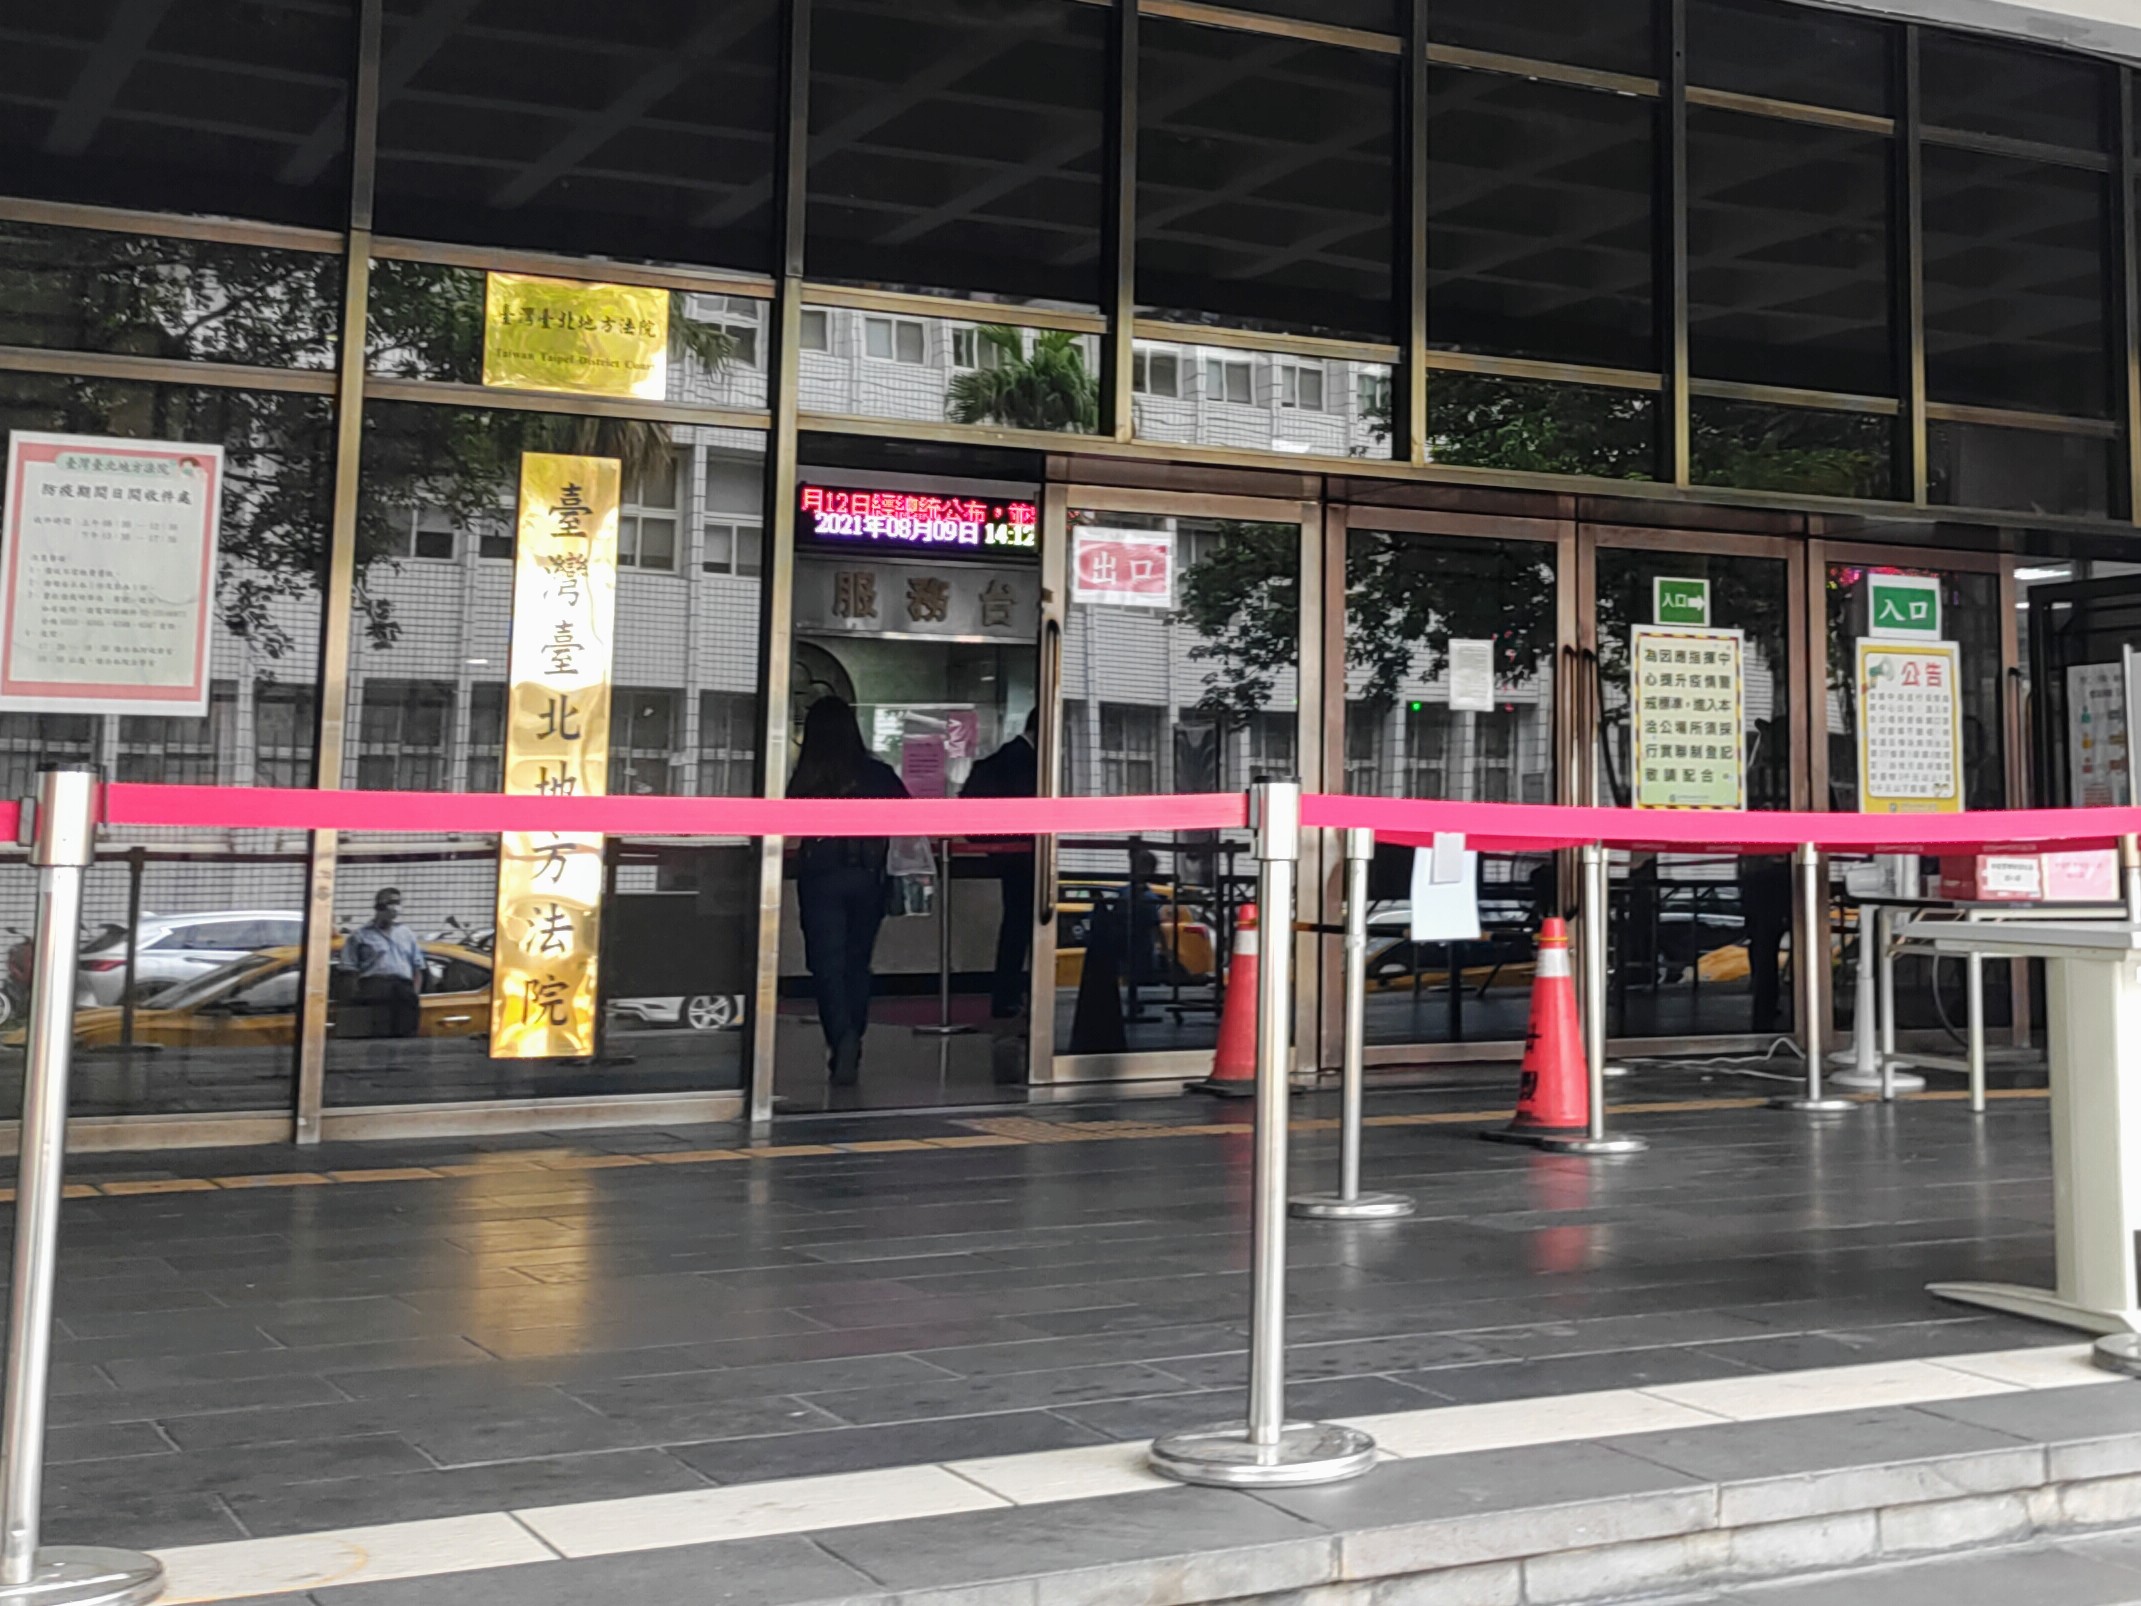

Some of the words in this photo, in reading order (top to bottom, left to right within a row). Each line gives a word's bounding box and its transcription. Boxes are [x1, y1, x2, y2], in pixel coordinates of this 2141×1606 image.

[499, 303, 657, 338] 臺灣臺北地方法院
[579, 356, 620, 368] District
[42, 483, 193, 506] 防疫期間日間收件處
[814, 513, 979, 545] 2021年08月09日
[984, 522, 1036, 546] 14:12
[1093, 551, 1153, 585] 出口
[832, 571, 1017, 627] 服務台
[1661, 592, 1687, 608] 入口
[1879, 599, 1928, 621] 入口
[1901, 661, 1942, 687] 公告
[521, 482, 592, 1027] 臺灣臺北地方法院
